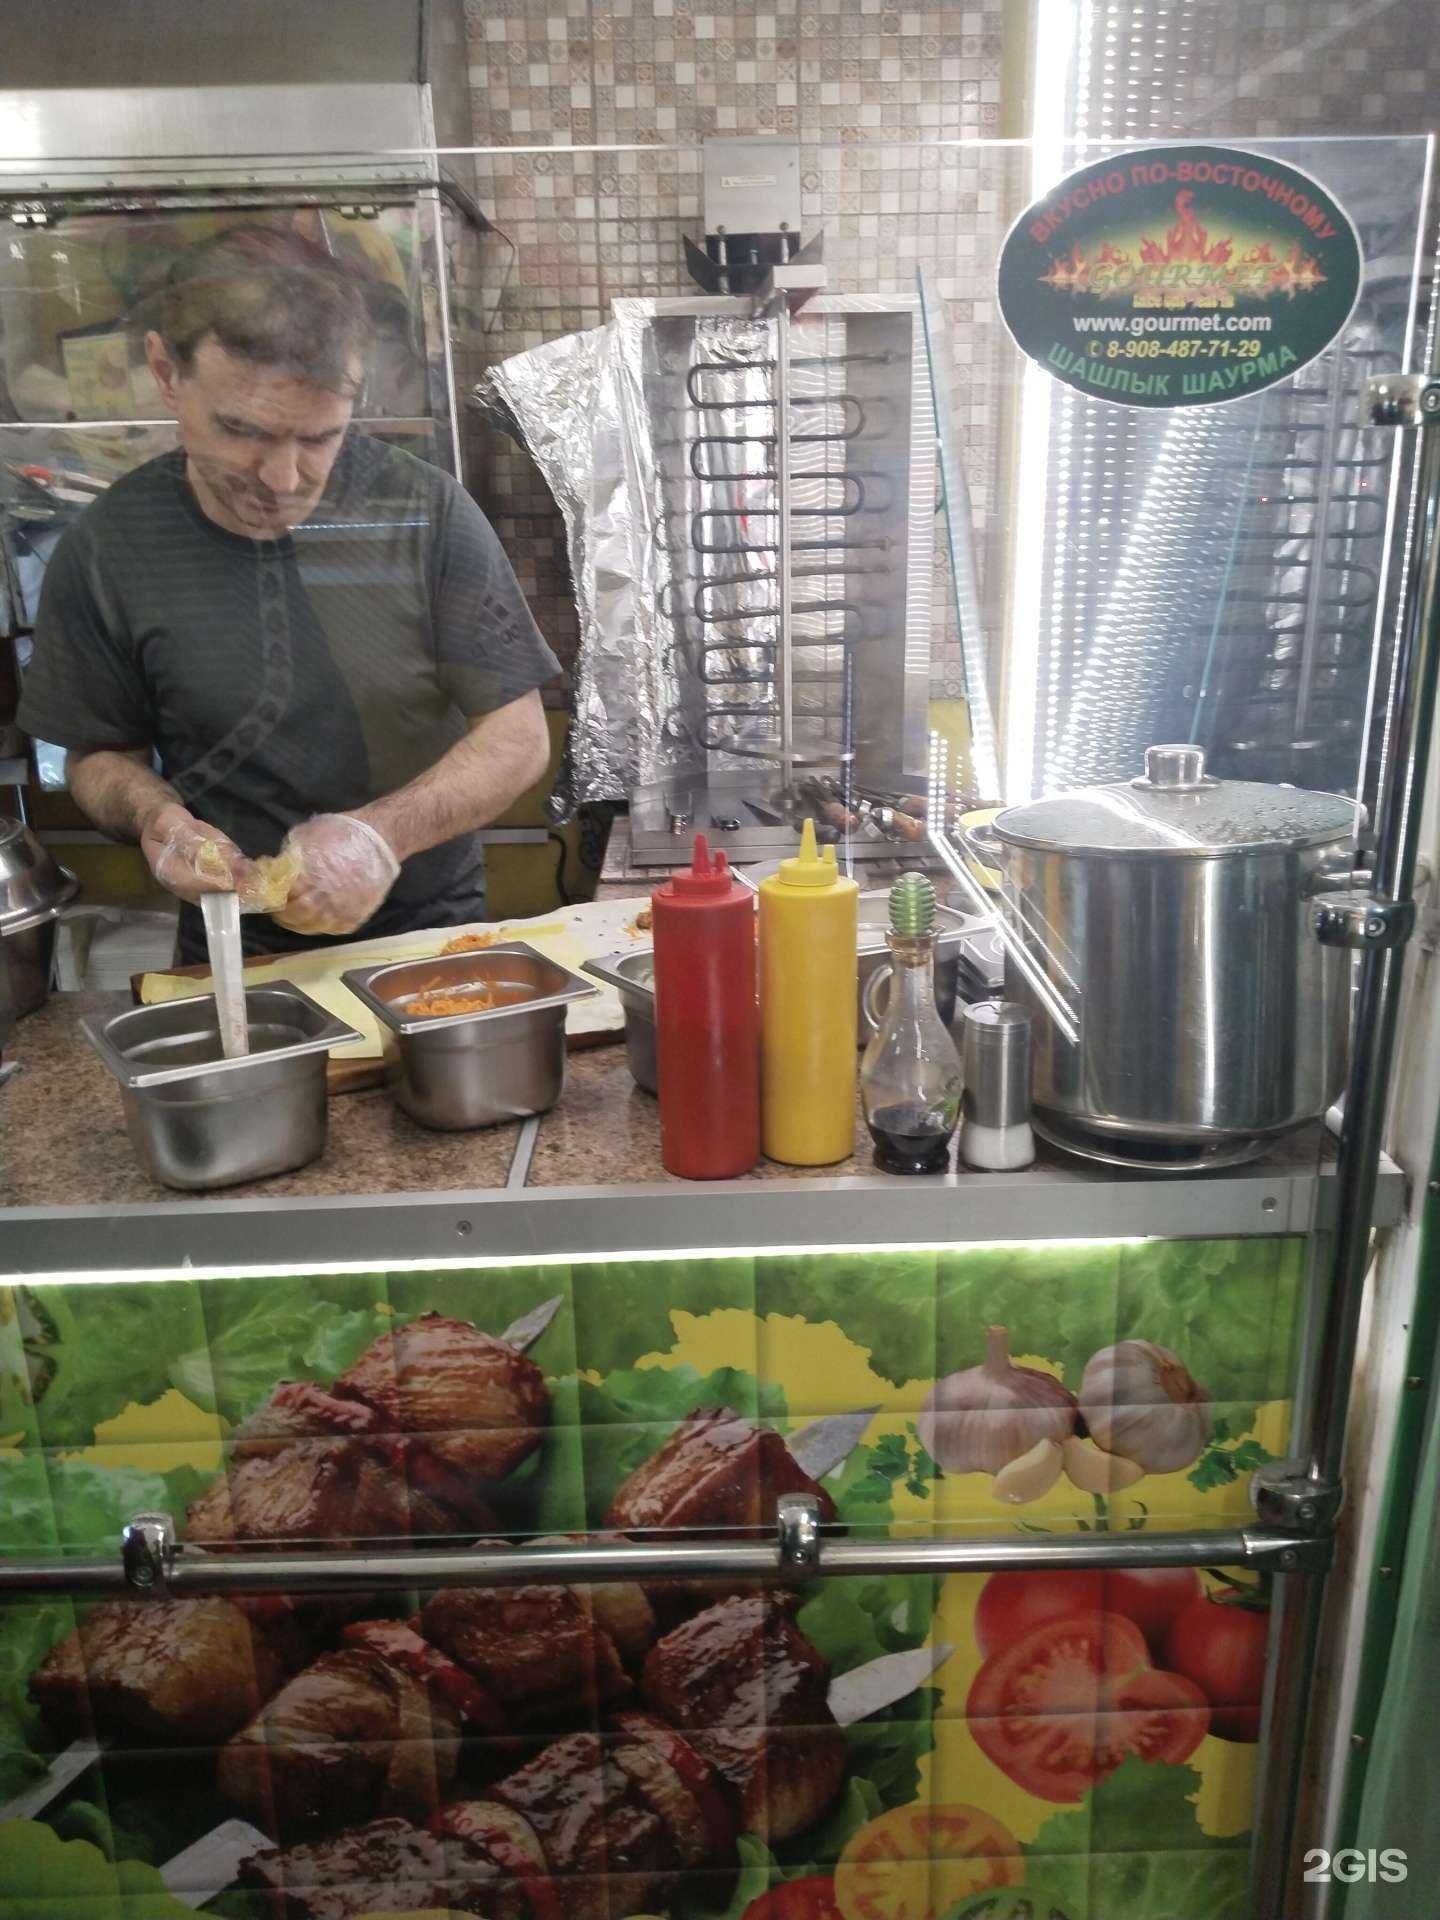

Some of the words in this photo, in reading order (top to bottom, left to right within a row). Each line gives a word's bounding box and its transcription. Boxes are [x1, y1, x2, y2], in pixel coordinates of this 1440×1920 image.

[1030, 170, 1125, 243] ВКУСНО
[1131, 160, 1337, 239] ПО-ВОСТОЧНОМУ
[1073, 313, 1272, 336] www.gourmet.com
[1106, 339, 1262, 358] 8-908-487-71-29
[1047, 341, 1170, 396] ШАШЛЫК
[1182, 344, 1298, 396] ШАУРМА
